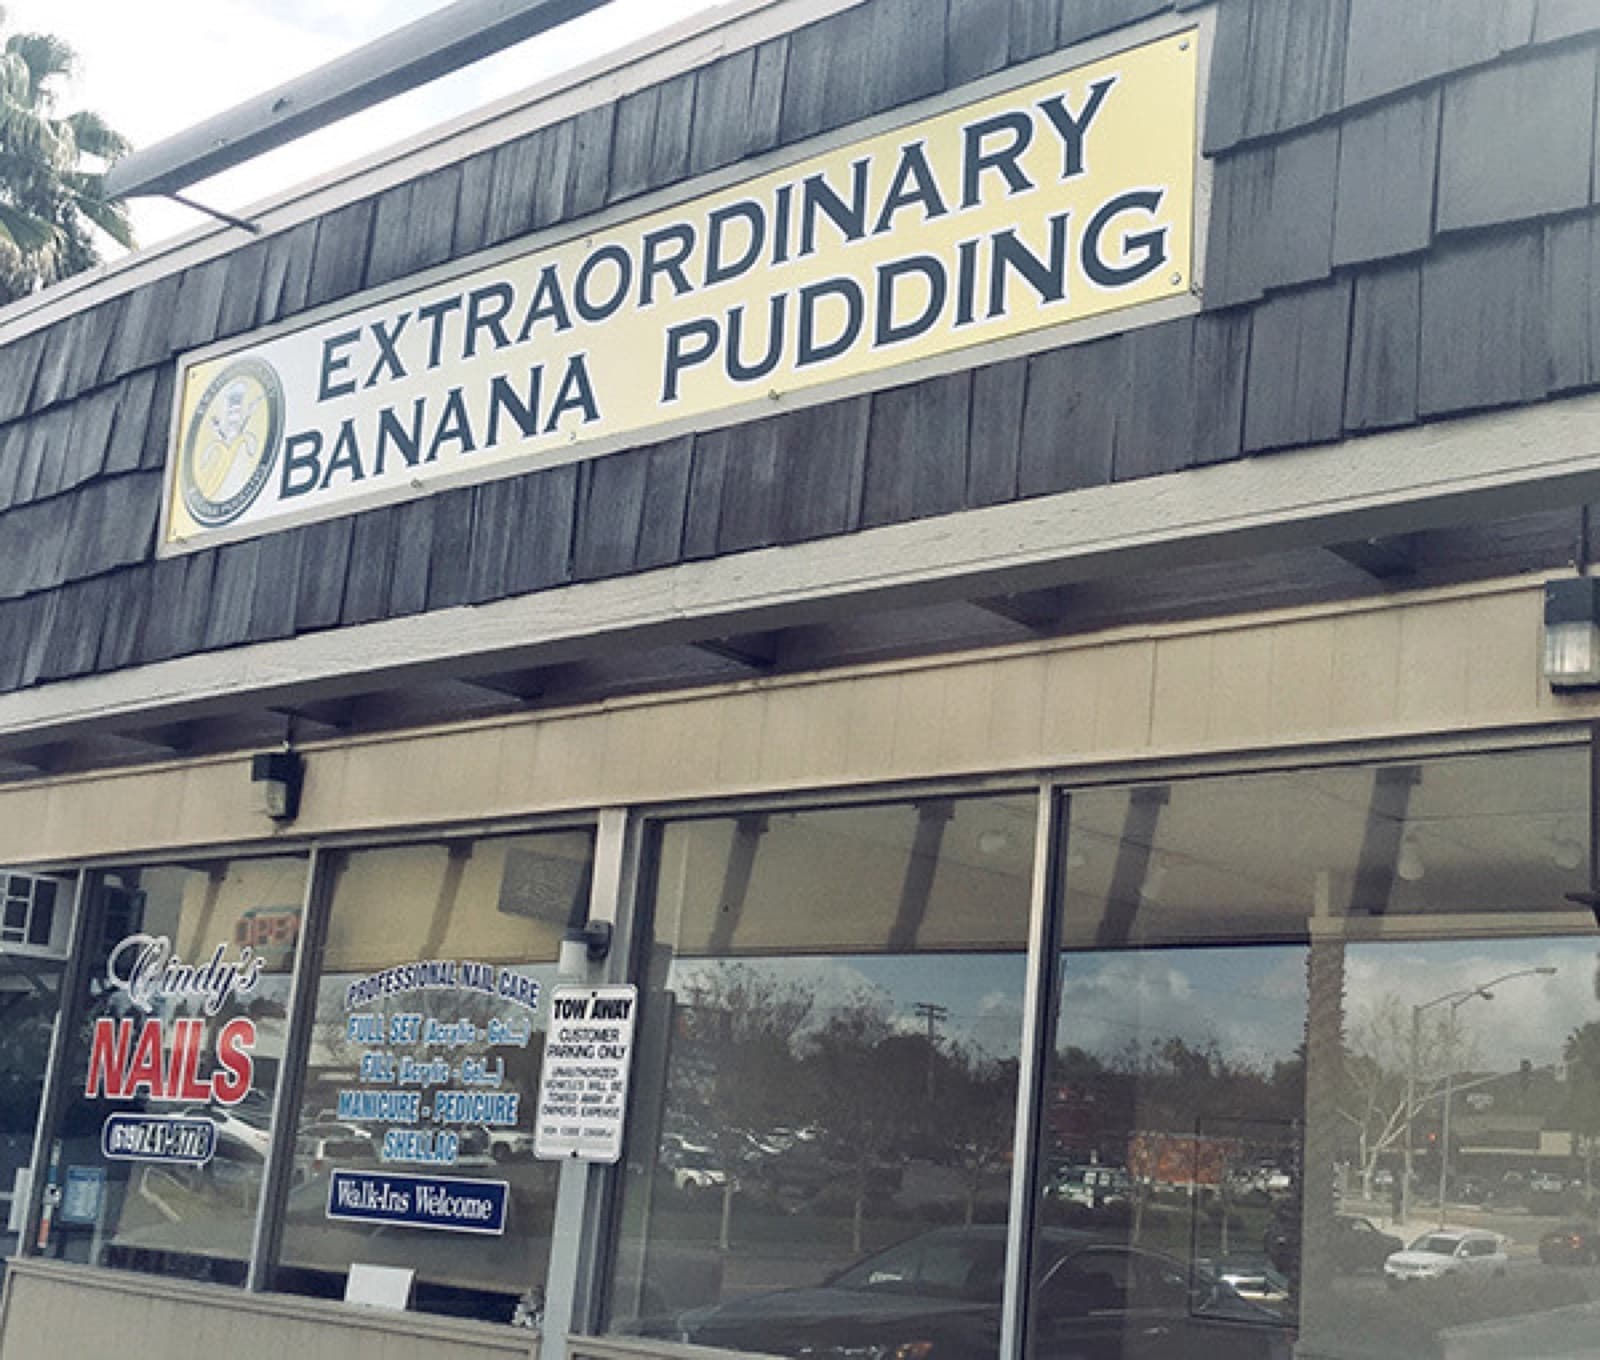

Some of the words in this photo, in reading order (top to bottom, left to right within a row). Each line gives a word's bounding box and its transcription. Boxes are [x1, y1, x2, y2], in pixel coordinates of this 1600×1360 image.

[317, 76, 1117, 402] EXTRAORDINARY
[278, 353, 601, 500] BANANA
[660, 188, 1169, 402] PUDDING
[107, 933, 266, 1016] Cindy's
[345, 960, 457, 1011] PROFESSIONAL
[460, 961, 495, 995] NAIL
[498, 968, 541, 1013] CARE
[554, 999, 588, 1020] TOW
[590, 999, 633, 1020] AWAY
[347, 1013, 384, 1044] FULL
[389, 1013, 423, 1045] SET
[559, 1028, 620, 1043] CUSTOMER
[85, 1017, 257, 1104] NAILS
[360, 1051, 395, 1083] FILL
[547, 1044, 595, 1059] PARKING
[597, 1044, 627, 1059] ONLY
[338, 1090, 422, 1124] MANICURE
[432, 1091, 520, 1126] PEDICURE
[381, 1128, 459, 1165] SHELLAC
[338, 1179, 411, 1213] Walk-Ins
[415, 1186, 492, 1220] Welcome
